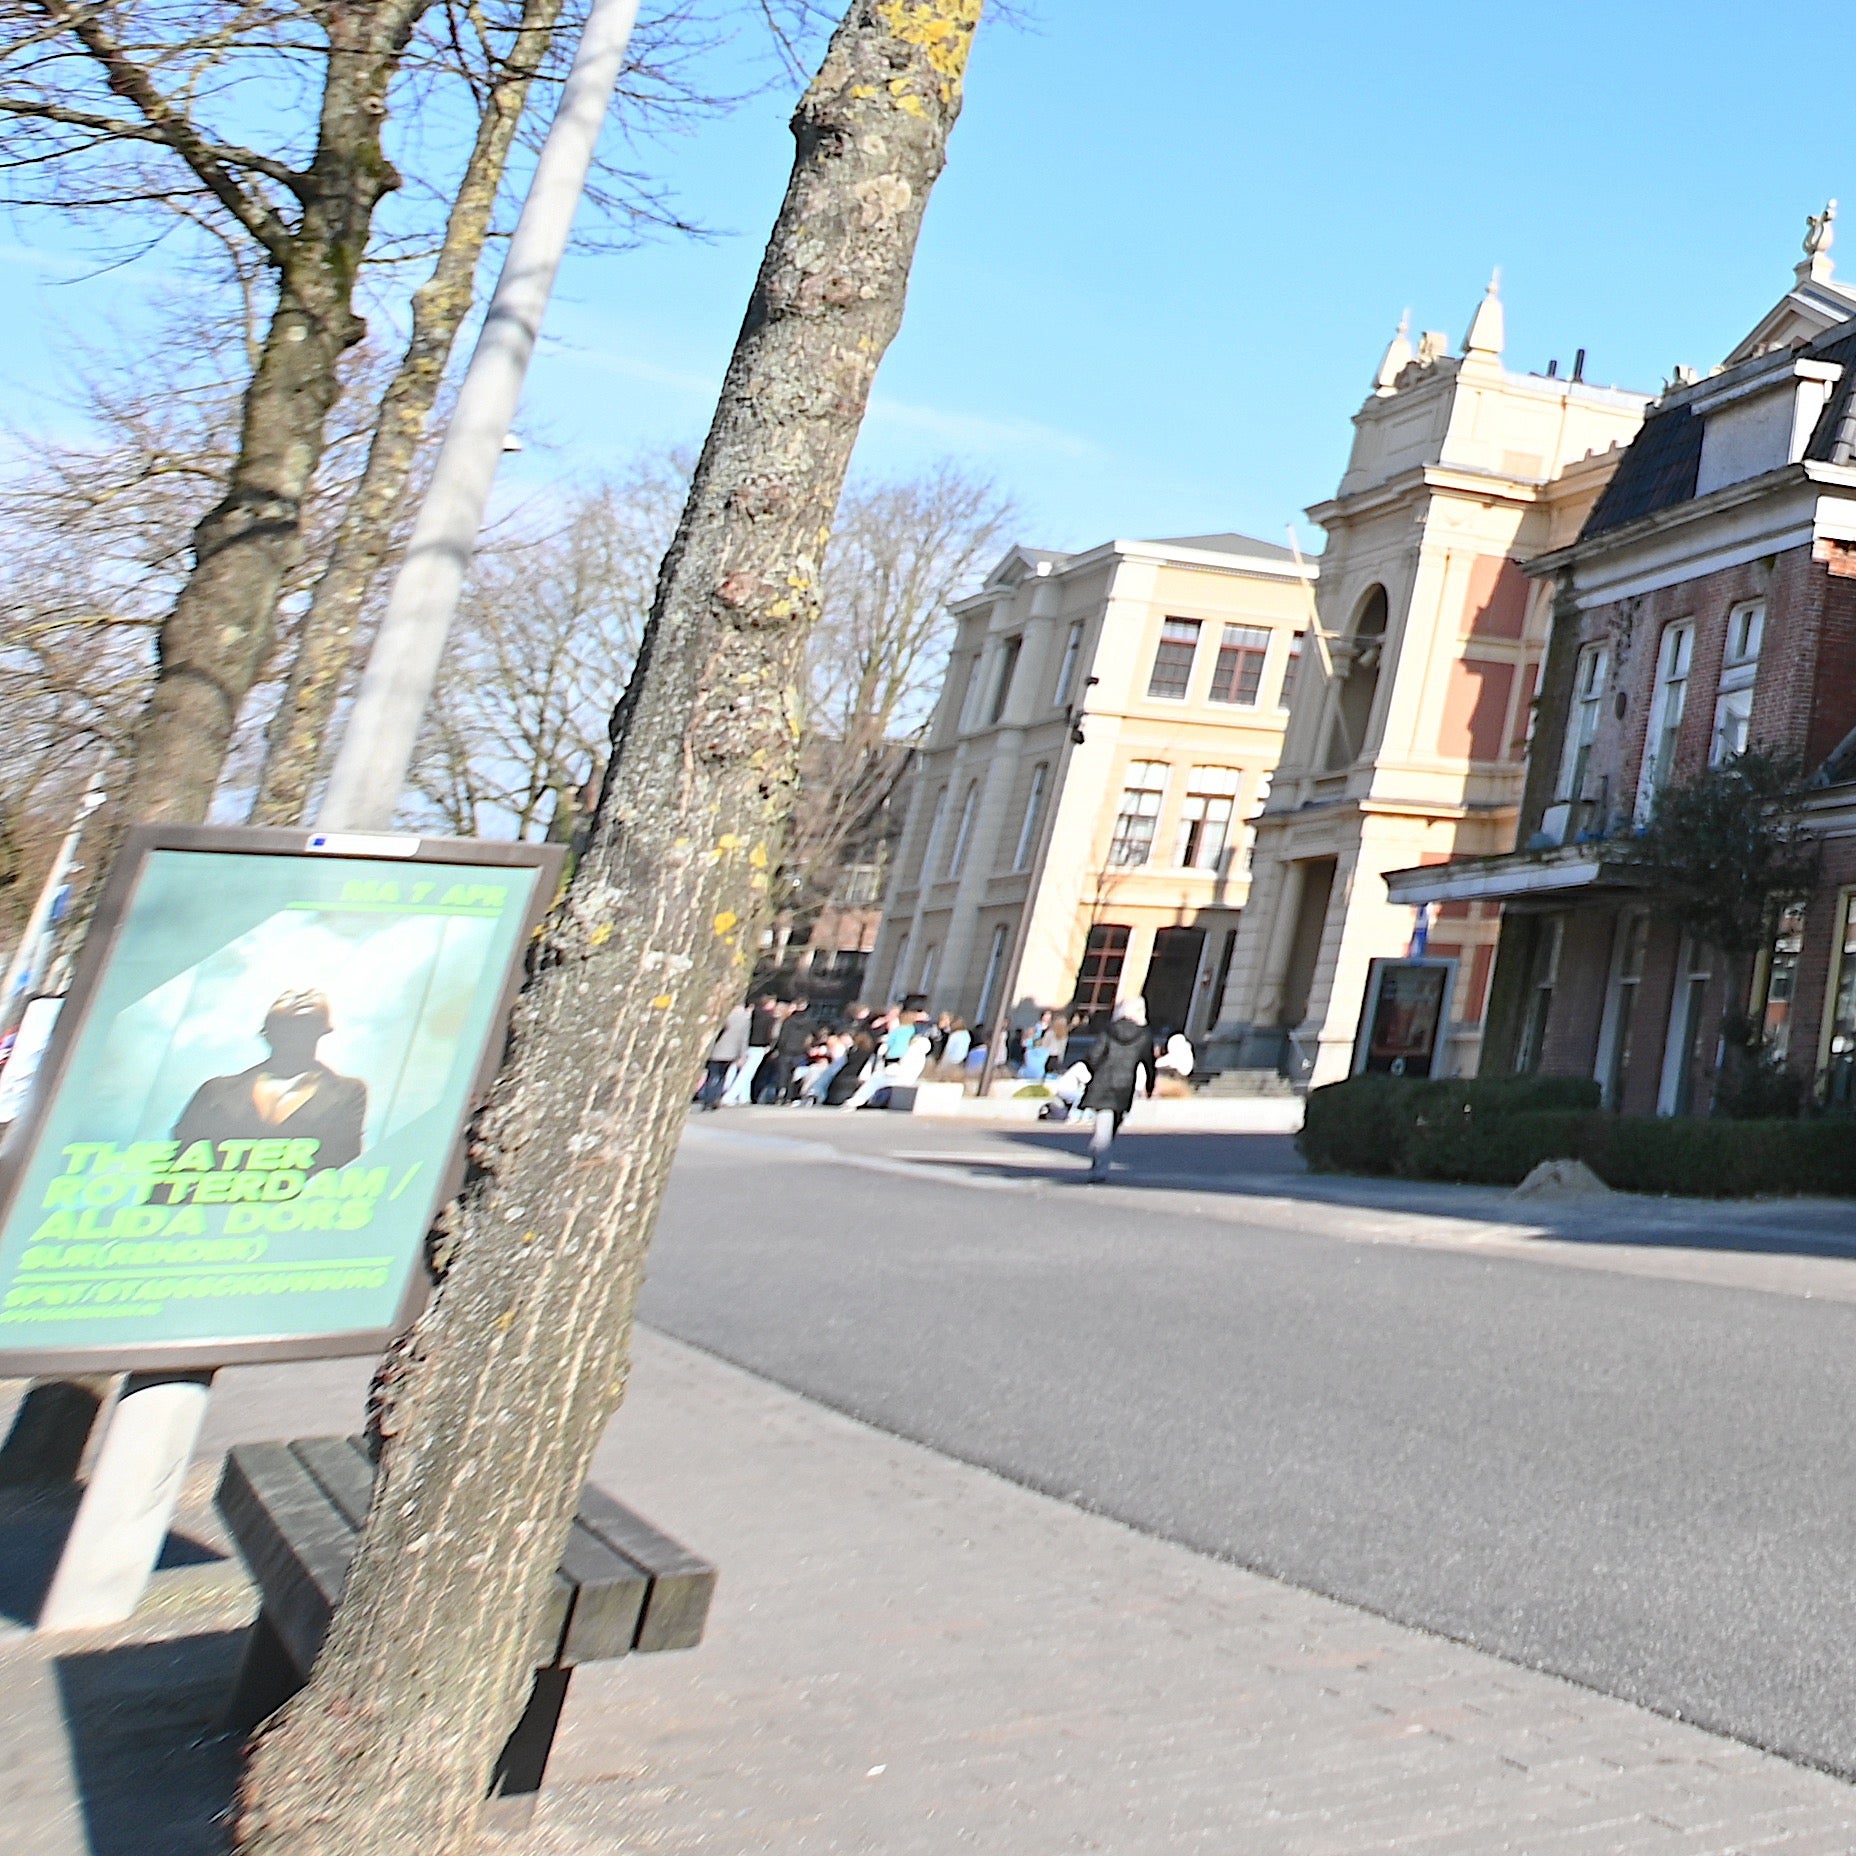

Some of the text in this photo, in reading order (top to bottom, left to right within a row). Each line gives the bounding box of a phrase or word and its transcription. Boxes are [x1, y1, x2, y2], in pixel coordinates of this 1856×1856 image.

[62, 1137, 322, 1174] THEATER
[41, 1166, 391, 1209] ROTTERDAM
[29, 1196, 376, 1242] ALIDA DORS
